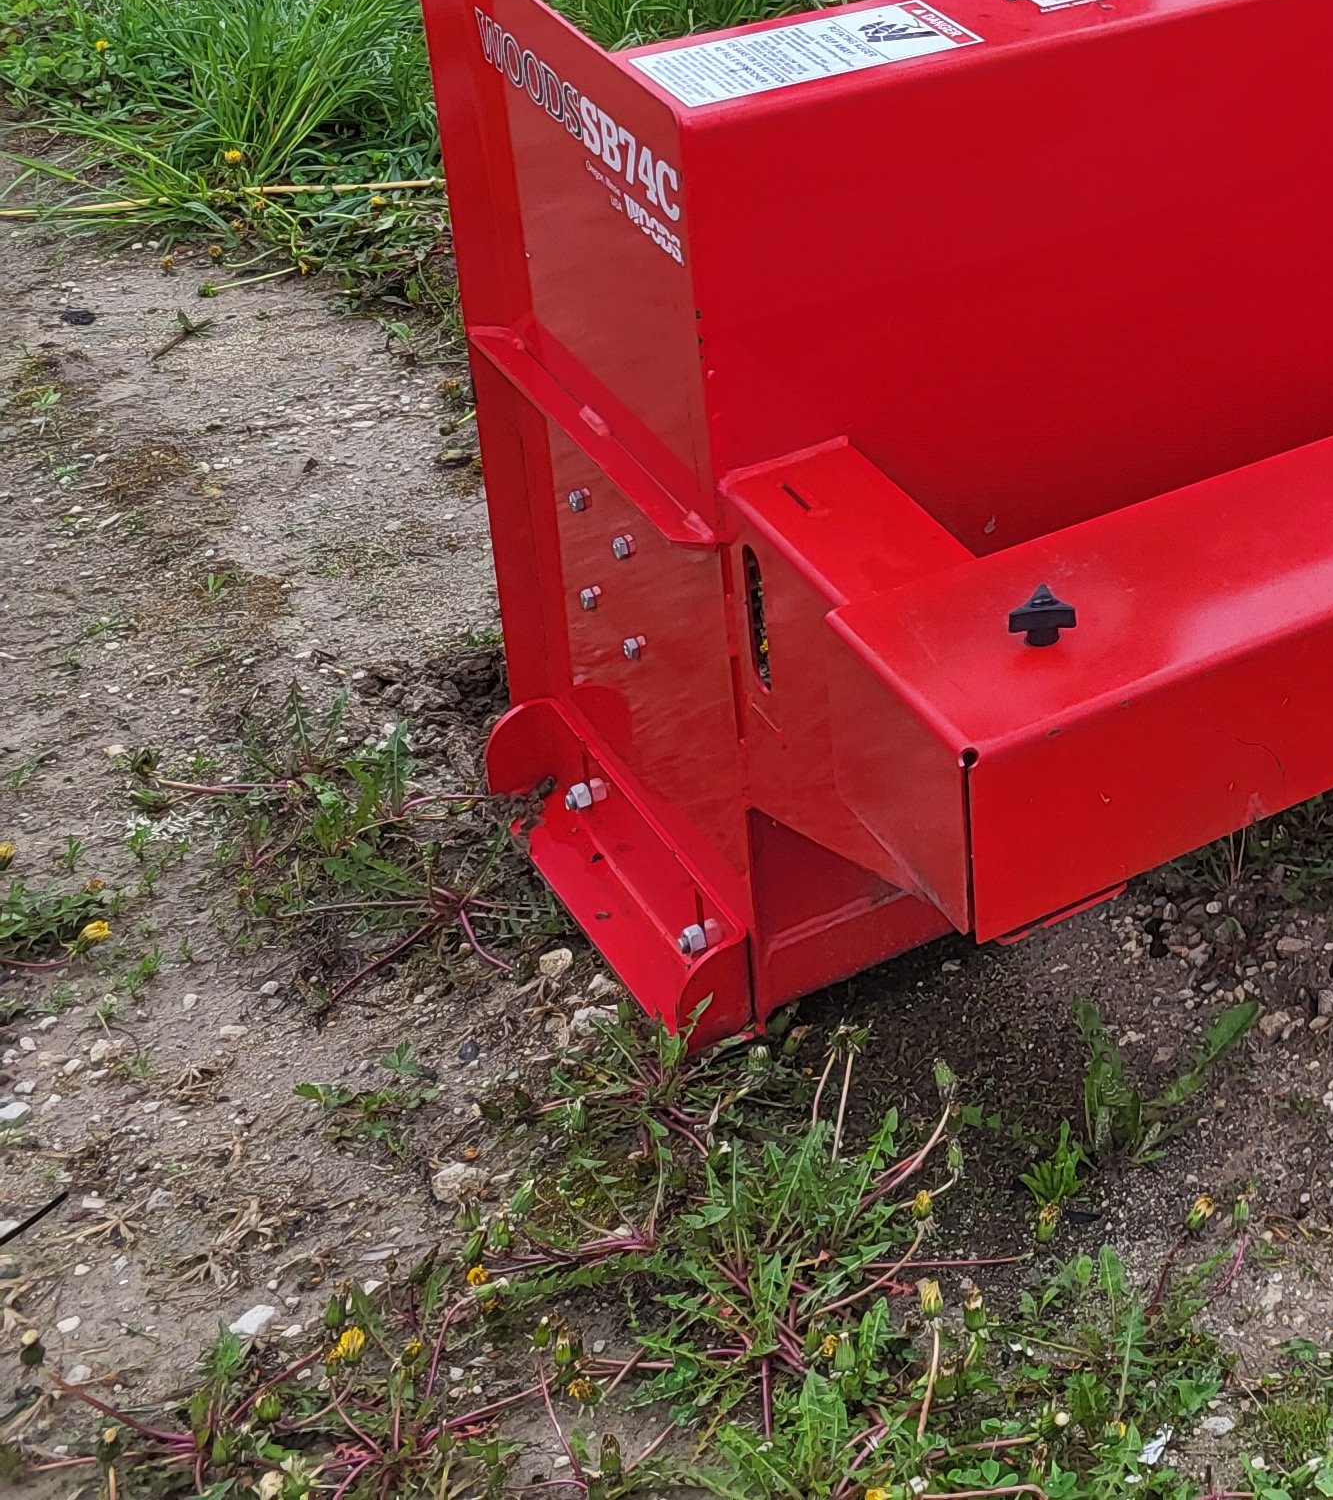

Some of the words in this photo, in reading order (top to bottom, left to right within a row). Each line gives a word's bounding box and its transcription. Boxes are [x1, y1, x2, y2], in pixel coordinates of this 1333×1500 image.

[920, 13, 963, 38] DANGER
[474, 6, 582, 141] WOODS
[579, 96, 682, 221] SB74C
[623, 192, 683, 263] WOODS
